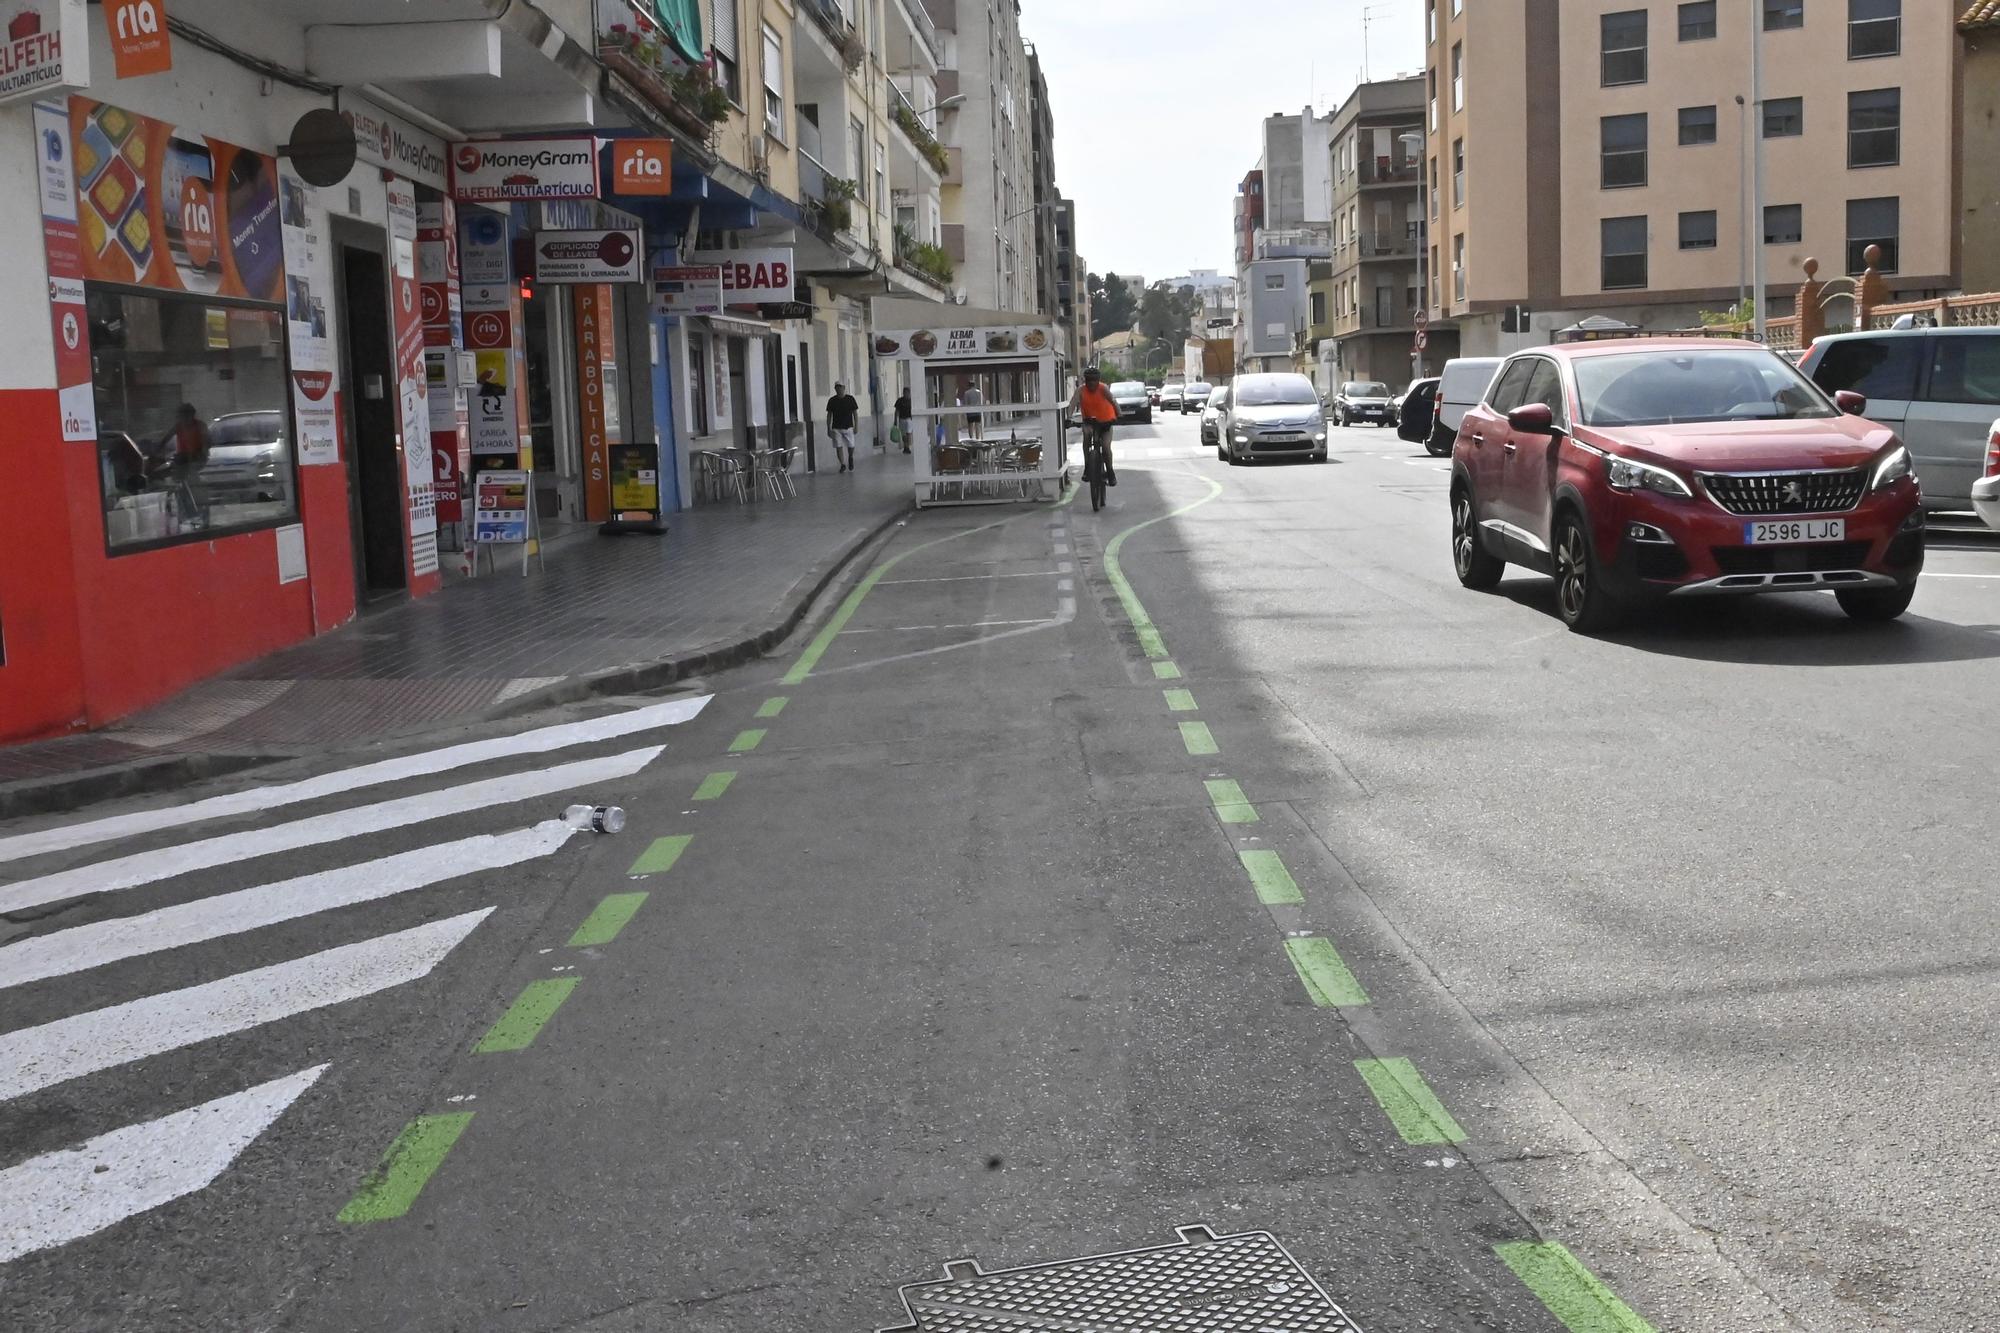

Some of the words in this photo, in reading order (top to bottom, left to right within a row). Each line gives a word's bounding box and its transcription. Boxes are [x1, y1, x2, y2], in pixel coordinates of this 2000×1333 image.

[117, 1, 158, 39] ria
[393, 131, 446, 177] MoneyGram
[481, 150, 588, 170] MoneyGram
[623, 148, 662, 176] ria
[184, 187, 211, 234] ria
[232, 223, 255, 248] Money
[550, 242, 600, 251] DUPLICADO
[553, 251, 564, 259] DE
[568, 251, 598, 259] LLAVES
[580, 262, 586, 270] O
[582, 270, 592, 278] SU
[594, 268, 630, 278] CERRADURA
[722, 260, 789, 290] ÉBAB
[421, 292, 436, 307] ia
[478, 320, 498, 333] ria
[949, 329, 974, 340] KEBAB
[947, 340, 958, 351] LA
[959, 339, 977, 350] TEJA
[582, 297, 603, 481] PARABÓLICAS
[65, 411, 80, 434] ria
[486, 440, 514, 448] HORAS
[433, 491, 457, 501] ERO
[1756, 523, 1801, 542] 2596
[1807, 521, 1839, 540] LJC
